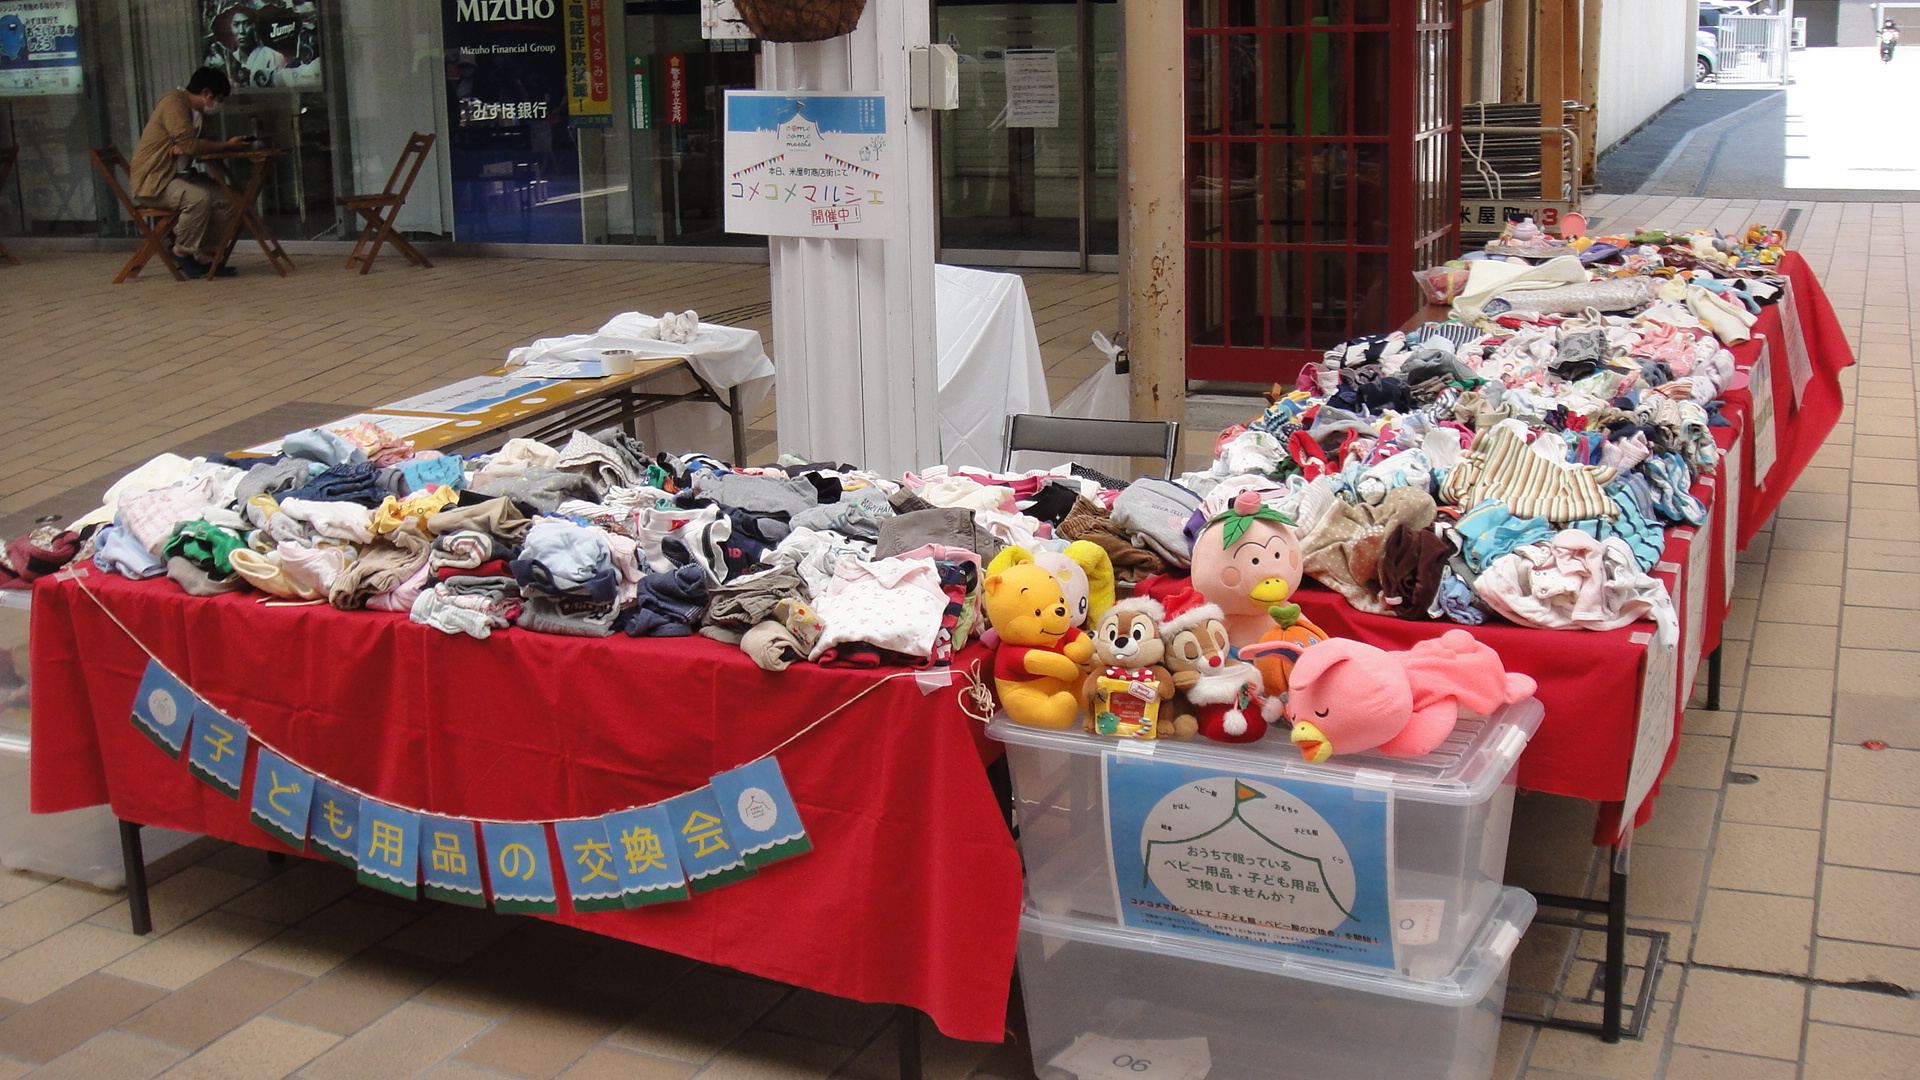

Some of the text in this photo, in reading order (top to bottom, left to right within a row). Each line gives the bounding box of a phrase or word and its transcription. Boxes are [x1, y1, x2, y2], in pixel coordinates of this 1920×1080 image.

[457, 0, 555, 22] MIZUHO
[460, 43, 556, 55] Mizuho Financial Group
[568, 0, 588, 112] 電話詐欺撲滅！
[473, 101, 548, 120] みずほ銀行
[786, 132, 812, 140] come
[1274, 803, 1299, 815] おもちゃ
[1293, 826, 1319, 837] 子ども服
[1187, 846, 1292, 872] おうちで眠っている
[1163, 858, 1320, 894] ベビー用品・子ども用品
[1186, 878, 1296, 905] 交換しませんか？
